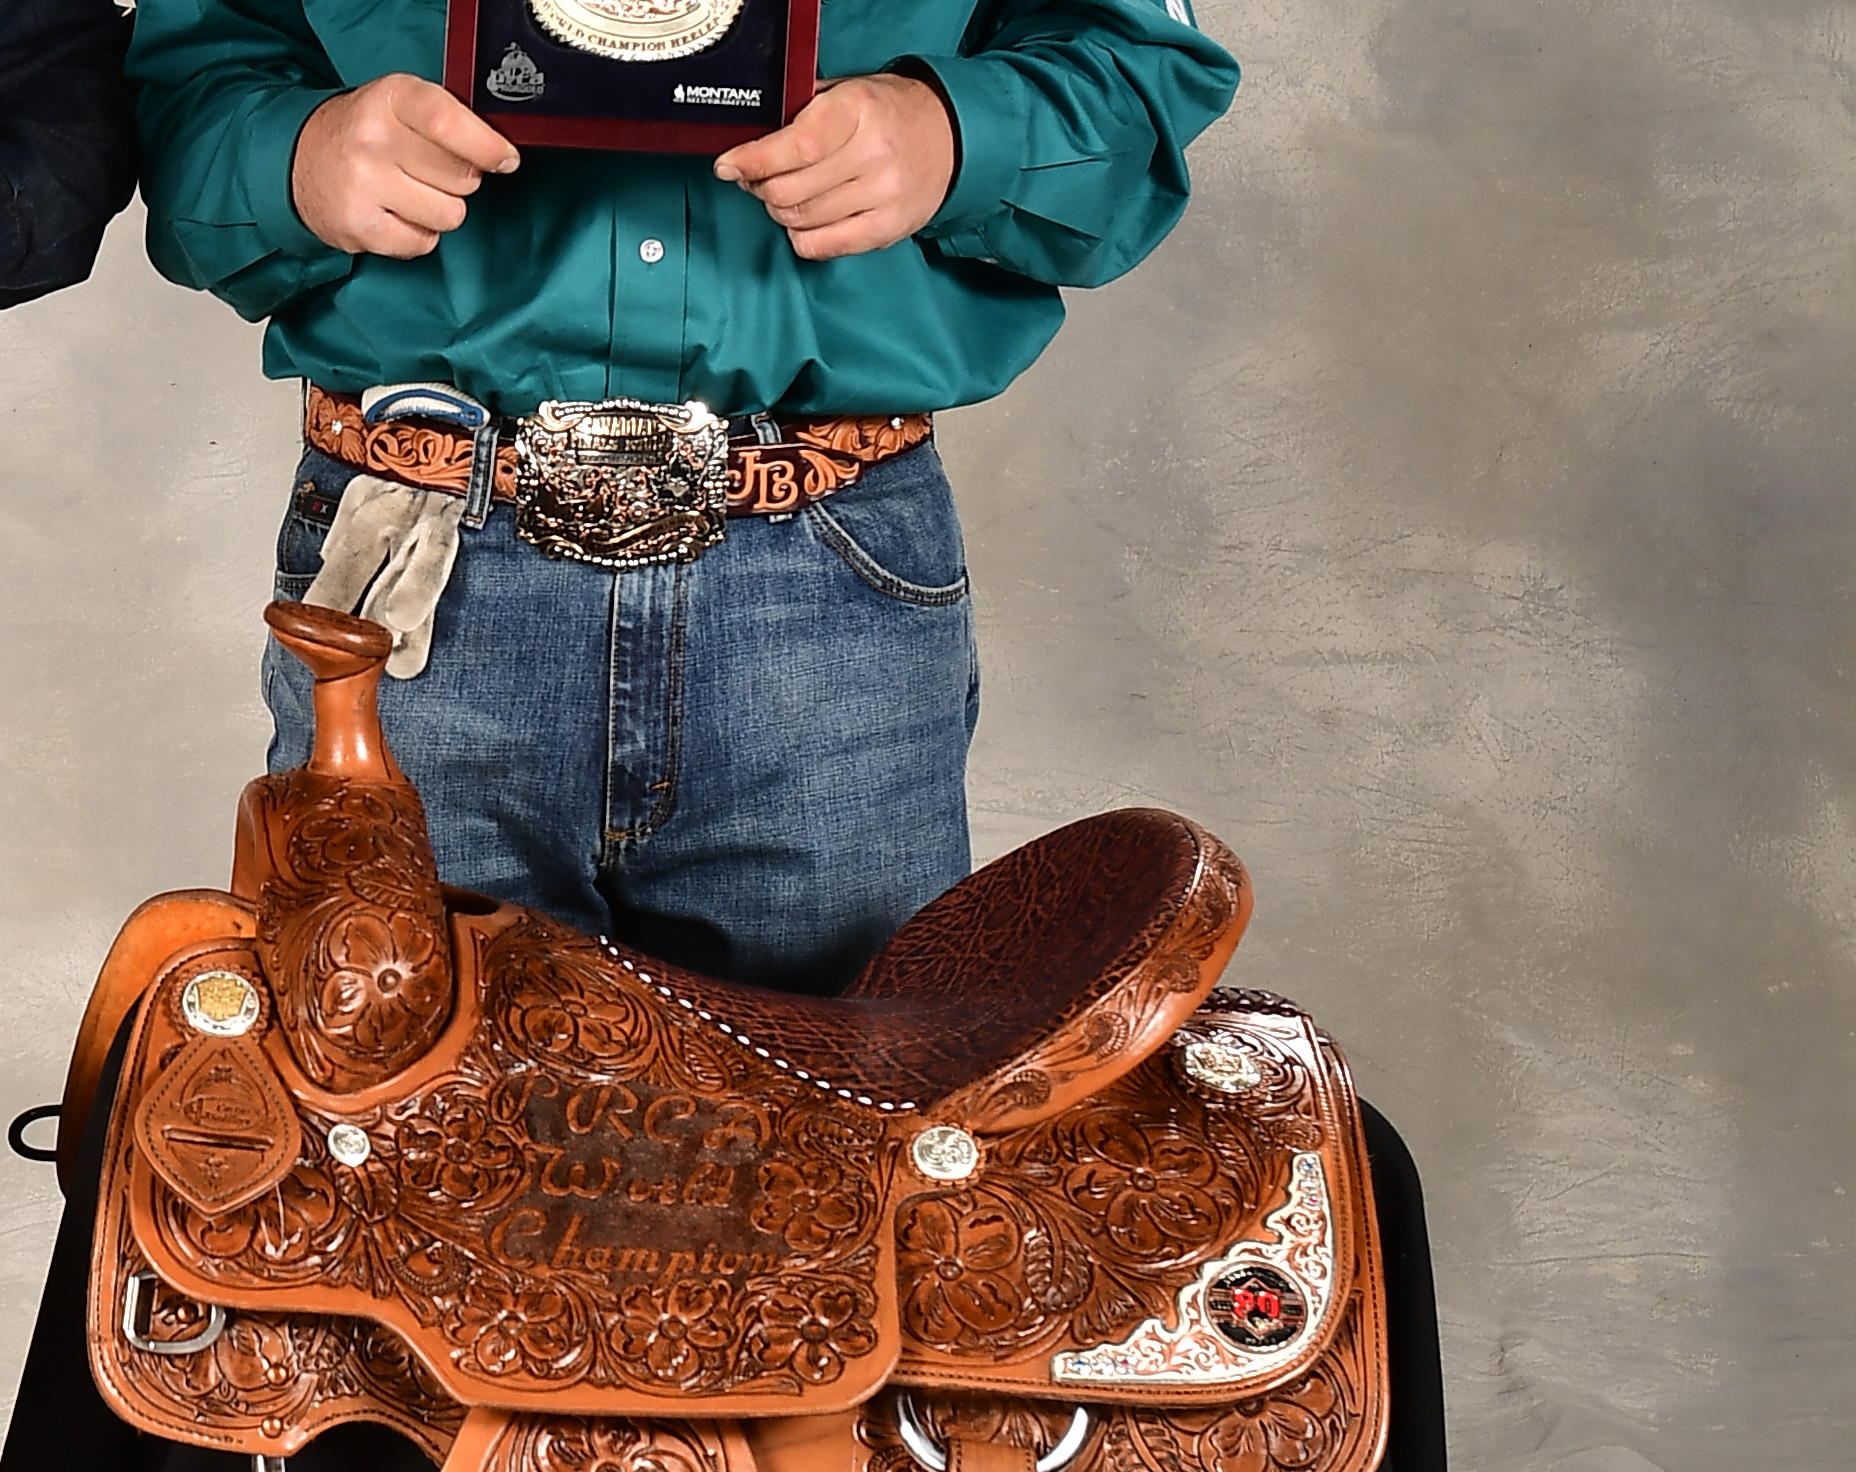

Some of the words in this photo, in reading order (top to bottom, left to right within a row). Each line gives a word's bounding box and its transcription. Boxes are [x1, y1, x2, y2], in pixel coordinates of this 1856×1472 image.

[587, 34, 666, 52] CHAMPION
[687, 85, 760, 101] MONTANA
[531, 1144, 736, 1208] World
[490, 1206, 780, 1296] Champion
